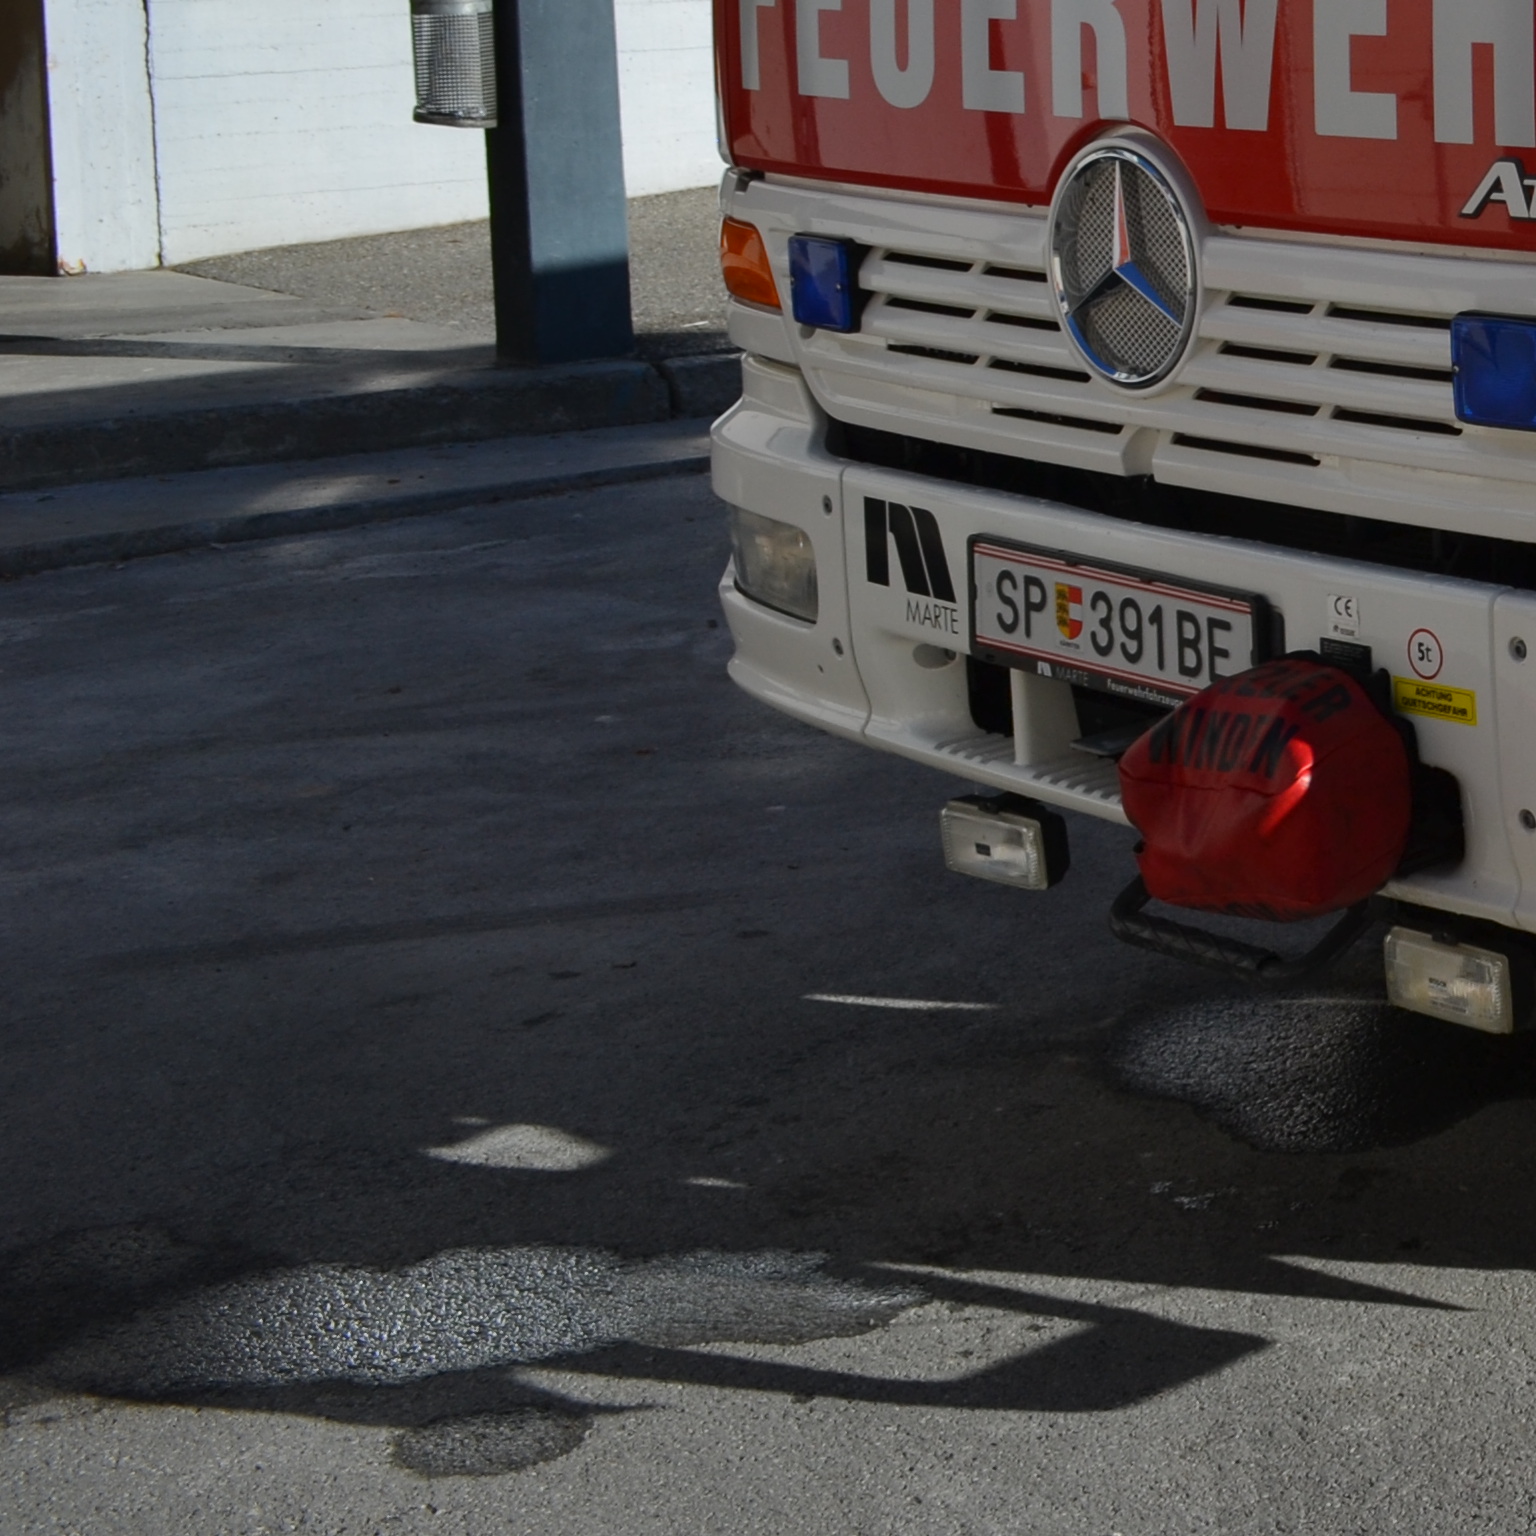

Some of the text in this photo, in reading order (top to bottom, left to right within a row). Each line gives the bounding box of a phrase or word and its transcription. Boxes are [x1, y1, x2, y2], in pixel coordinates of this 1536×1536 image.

[905, 598, 960, 635] MARTE
[996, 569, 1048, 639] SP
[1415, 687, 1453, 703] ACHTUNG
